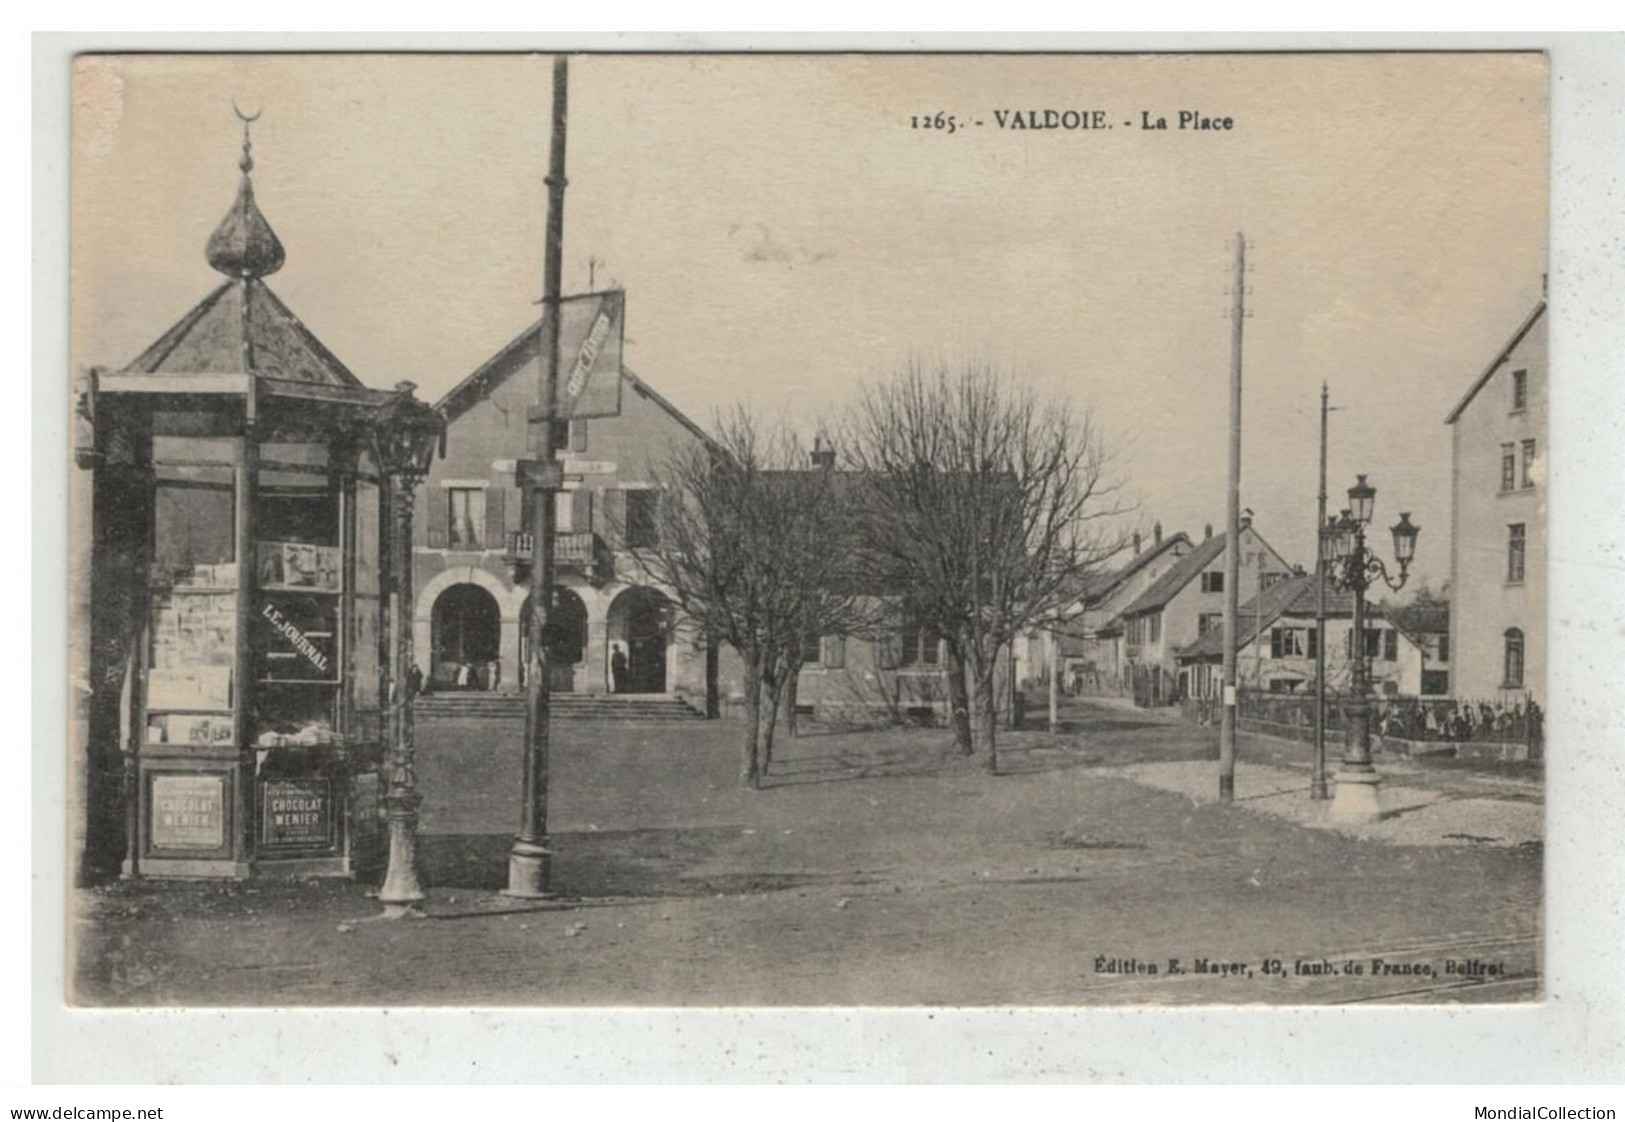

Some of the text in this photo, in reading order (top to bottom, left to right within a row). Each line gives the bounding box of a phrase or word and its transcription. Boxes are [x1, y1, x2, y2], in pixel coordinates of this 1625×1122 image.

[262, 603, 328, 671] LE JOURNAL
[272, 798, 322, 811] CHOCOLAT
[275, 813, 319, 825] MENIER
